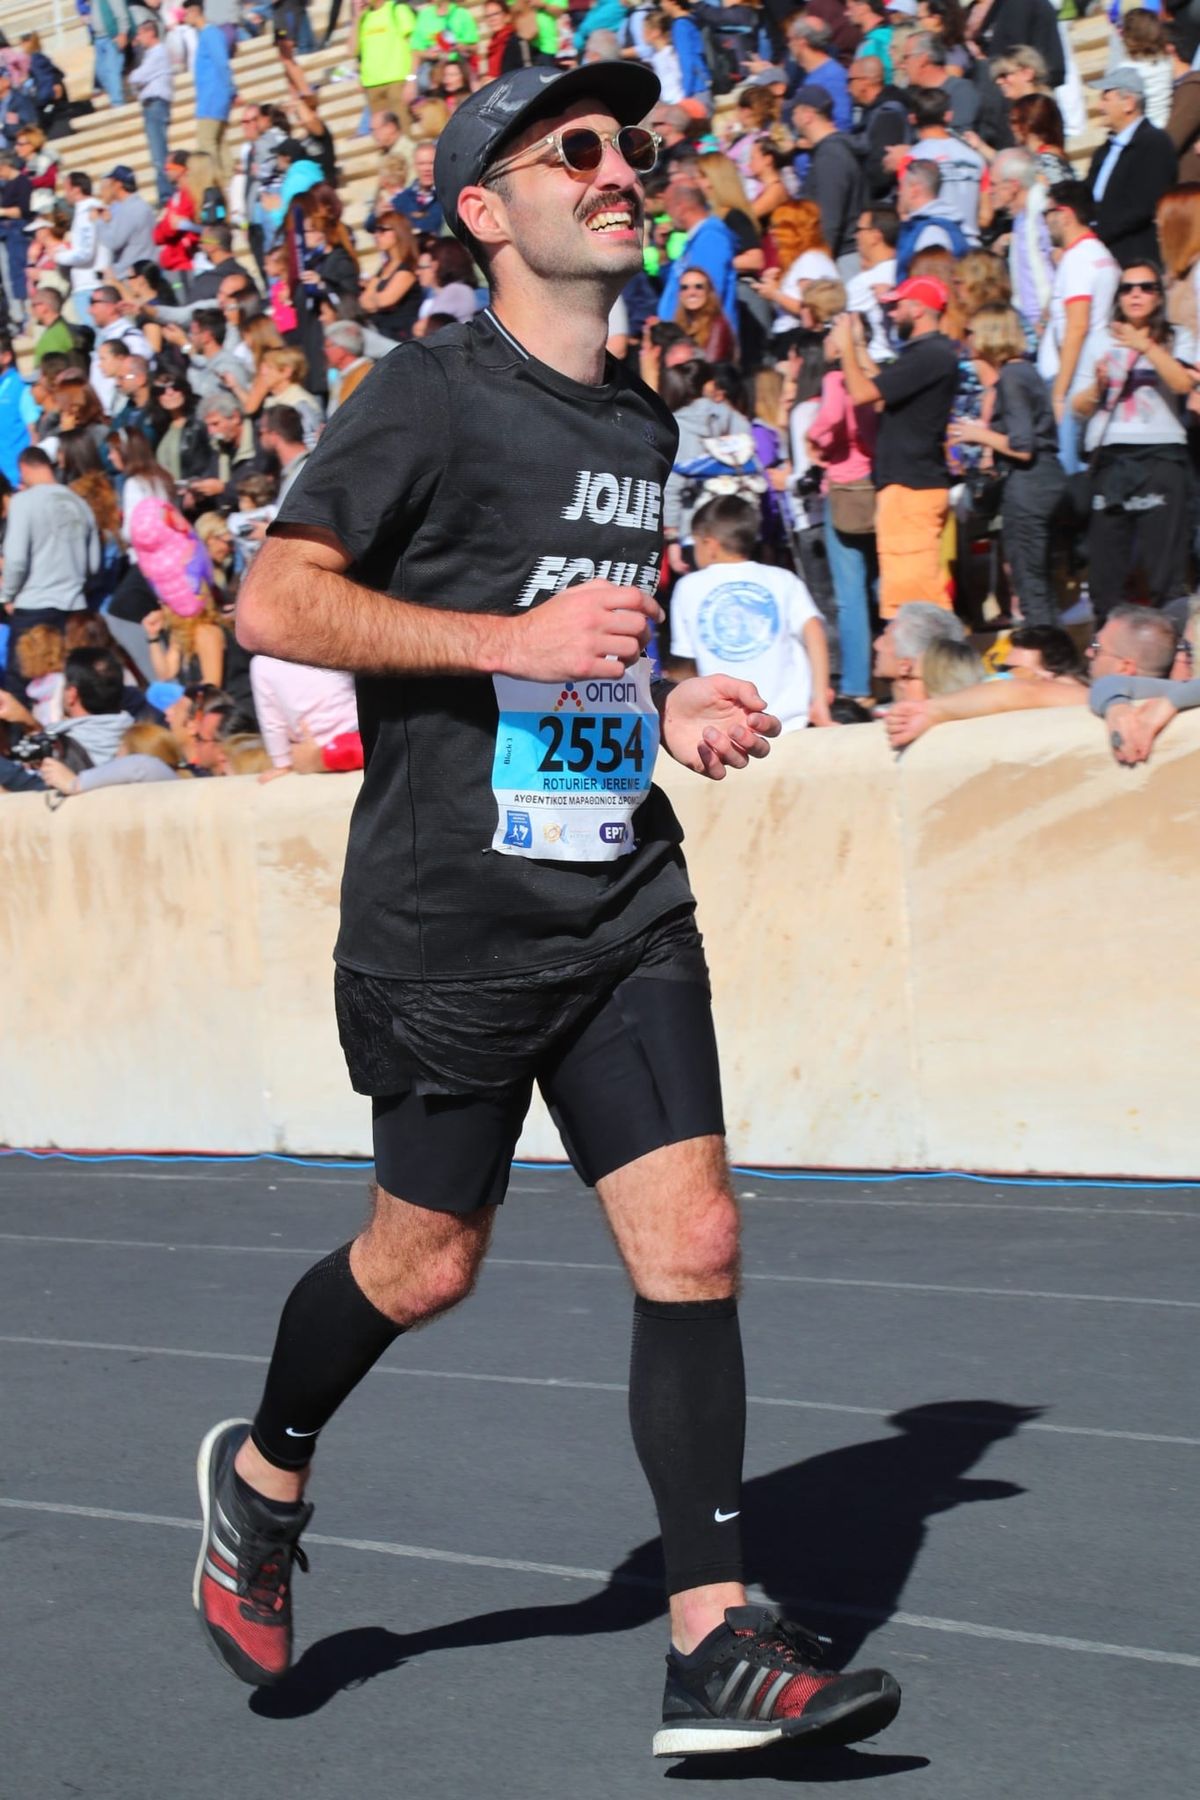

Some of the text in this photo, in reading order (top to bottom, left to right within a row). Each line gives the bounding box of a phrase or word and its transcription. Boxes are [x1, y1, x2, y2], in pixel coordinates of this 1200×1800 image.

[559, 470, 662, 532] JOLIE
[537, 715, 645, 773] 2554
[514, 793, 567, 806] ΑΥΘΕΝΤΙΚΟΣ
[569, 795, 617, 806] ΜΑΡΑΘΩΝΙΟΣ
[543, 777, 598, 791] ROTURIER
